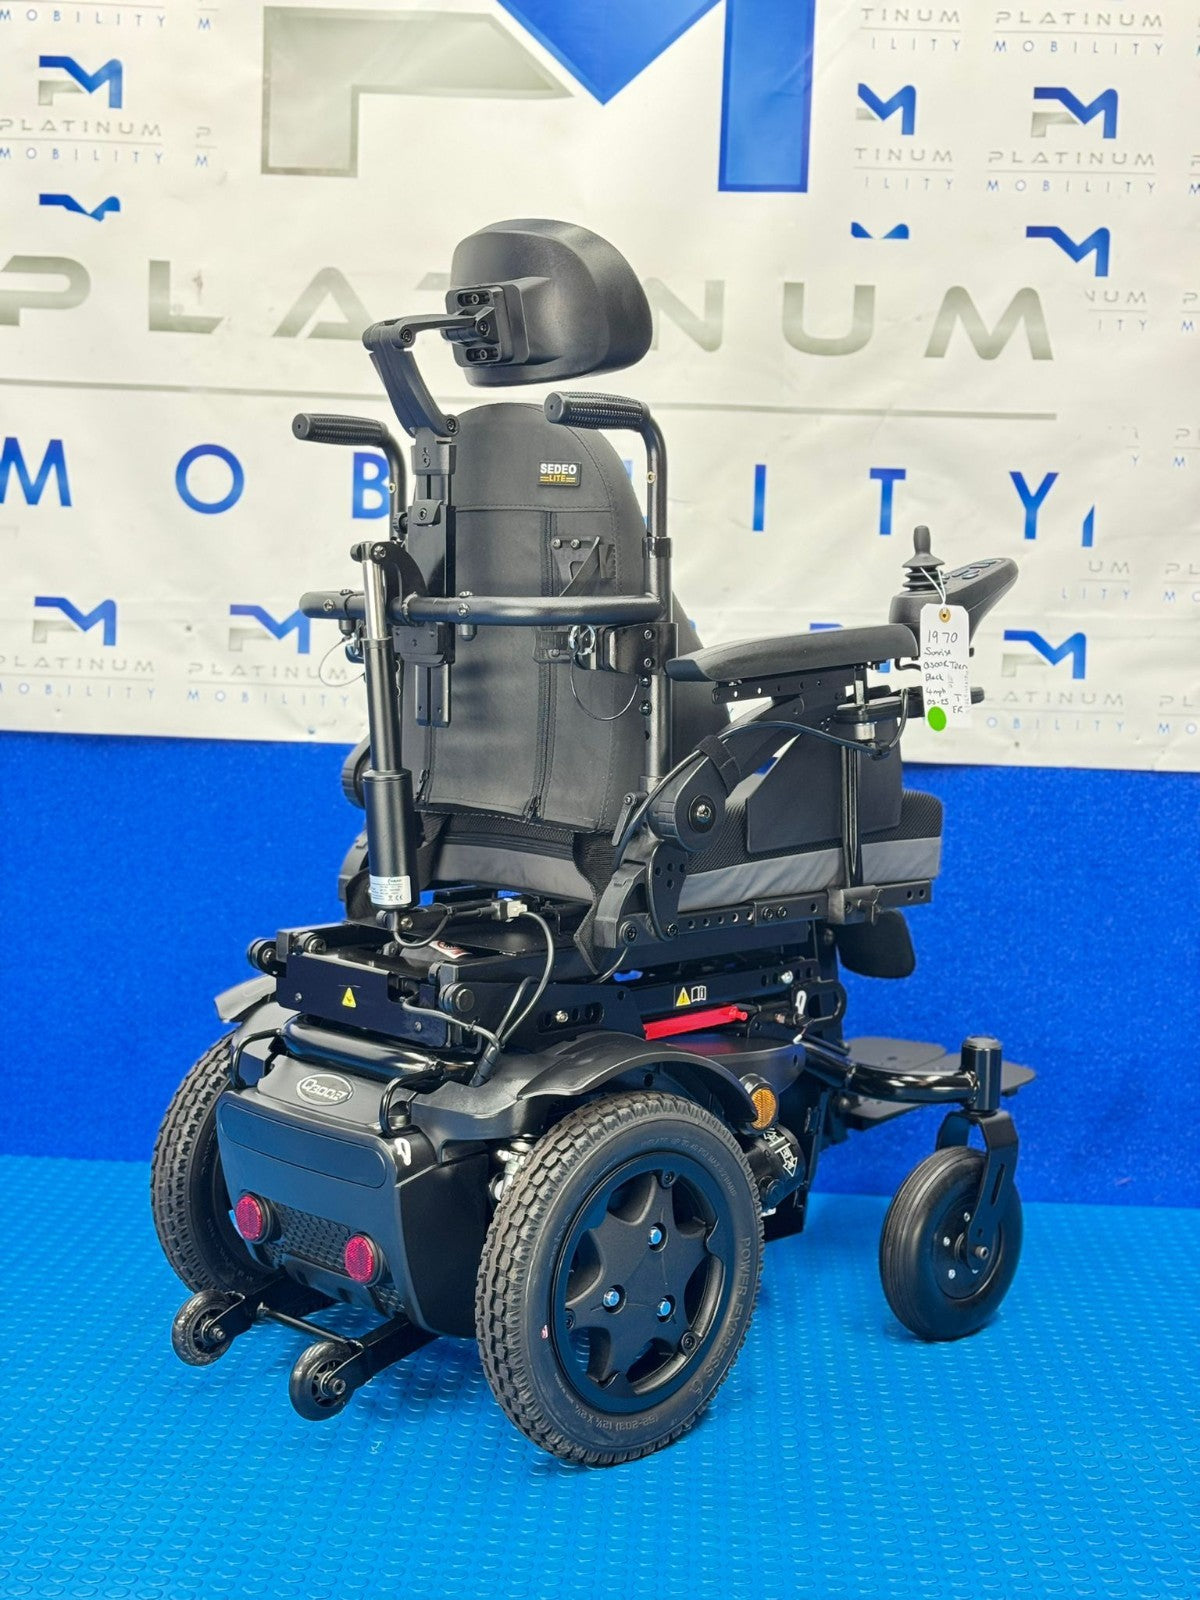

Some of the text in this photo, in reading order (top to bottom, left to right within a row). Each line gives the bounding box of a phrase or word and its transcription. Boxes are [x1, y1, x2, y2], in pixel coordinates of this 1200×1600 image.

[0, 9, 165, 28] MOBILITY
[995, 11, 1162, 27] PLATINUM
[993, 40, 1164, 55] MOBILITY
[0, 118, 162, 137] PLATINUM
[0, 147, 164, 165] MOBILITY
[988, 150, 1155, 167] PLATINUM
[986, 180, 1155, 194] MOBILITY
[0, 254, 1054, 362] PLANUM
[540, 463, 577, 474] SEDEO
[927, 630, 958, 644] 1970
[188, 662, 349, 680] PLATINUM
[187, 689, 349, 706] MOBILITY
[735, 1236, 752, 1297] POWER
